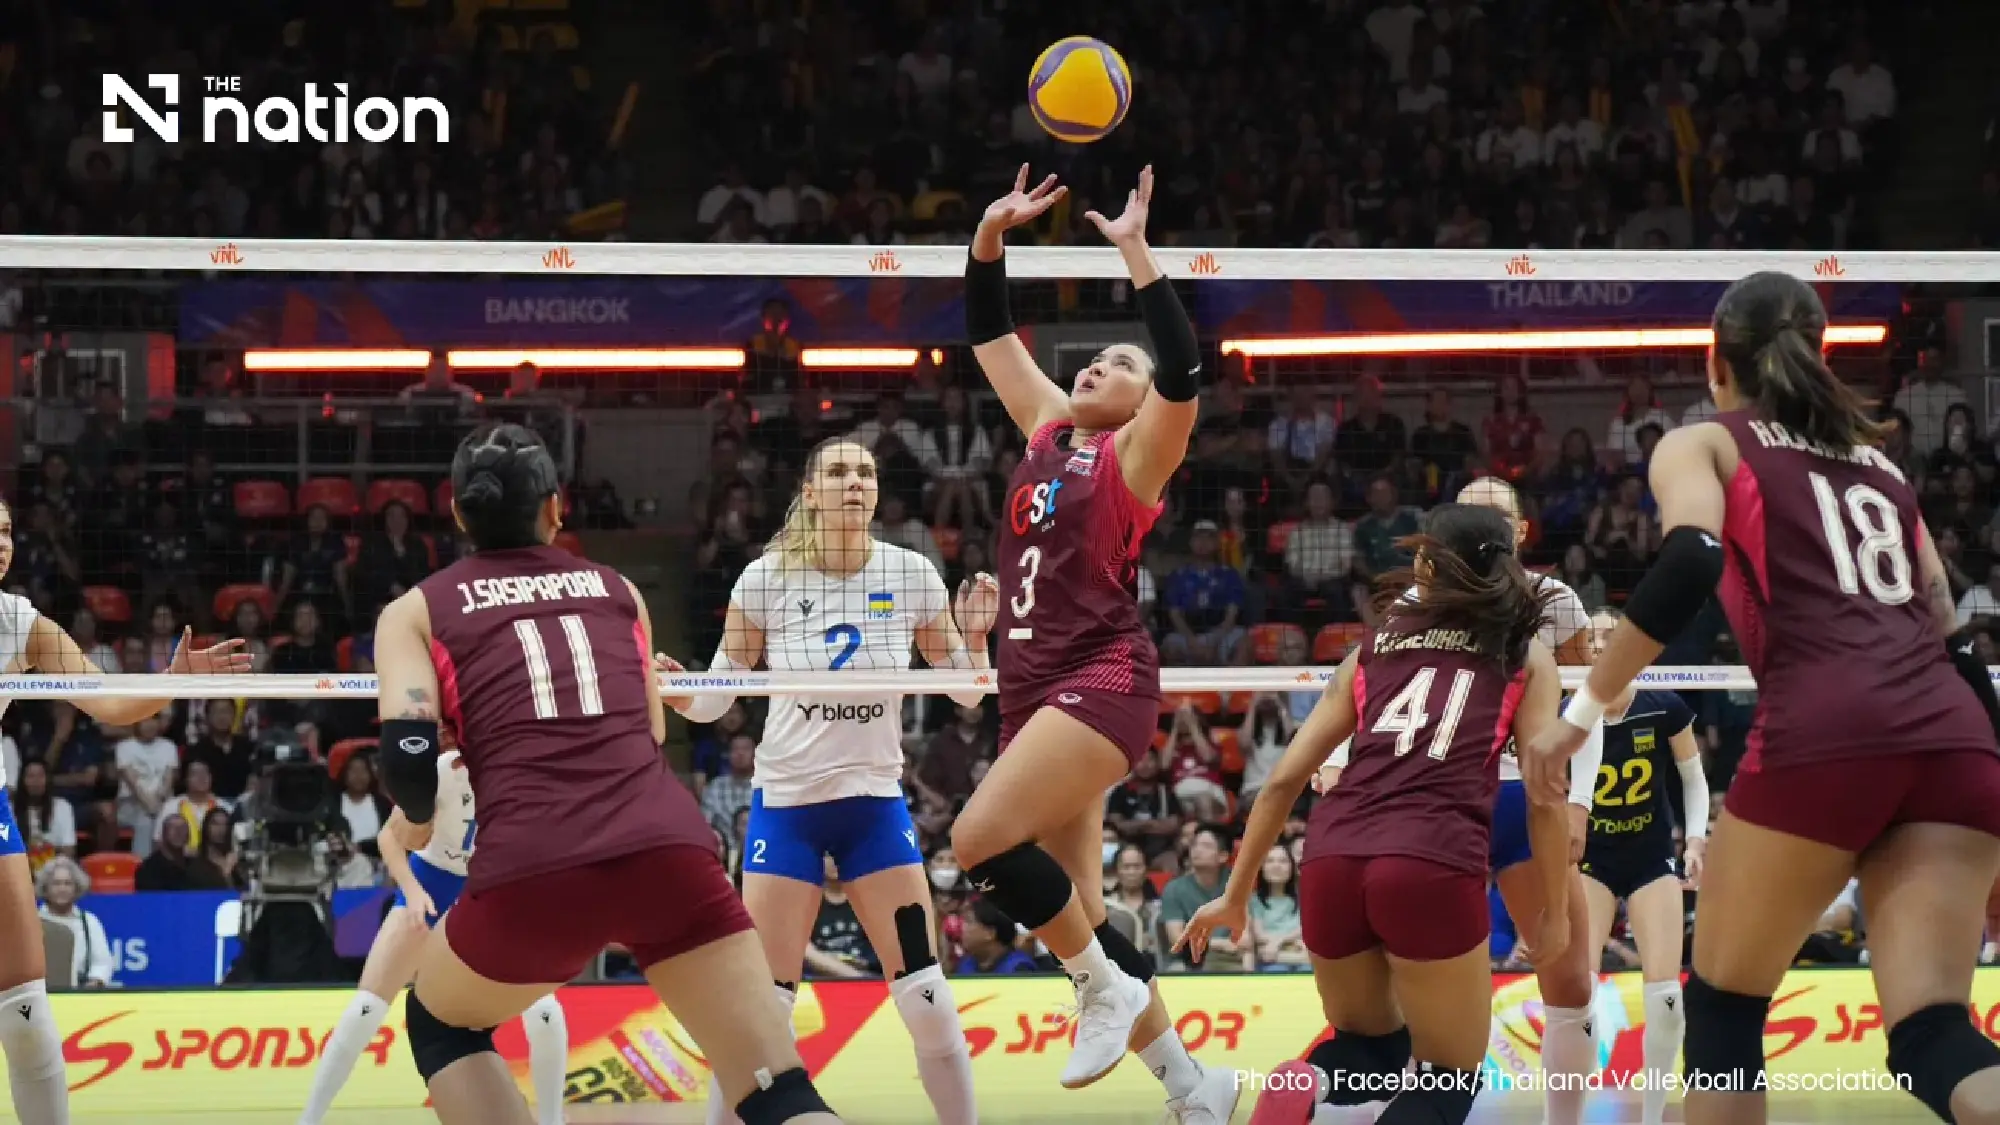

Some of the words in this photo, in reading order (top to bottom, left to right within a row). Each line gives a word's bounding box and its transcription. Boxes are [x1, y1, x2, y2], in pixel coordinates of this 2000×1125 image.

[485, 298, 630, 324] BANGKOK
[1487, 282, 1633, 308] THAILAND
[1011, 477, 1063, 536] est
[1808, 471, 1914, 605] 18
[1011, 545, 1041, 619] 3
[514, 614, 604, 720] 11
[824, 623, 863, 671] 2
[0, 681, 75, 690] VOLLEYBALL
[670, 678, 744, 687] VOLLEYBALL
[1636, 672, 1705, 682] VOLLEYBALL
[1371, 666, 1475, 761] 41
[1595, 758, 1653, 807] 22
[752, 839, 767, 863] 2
